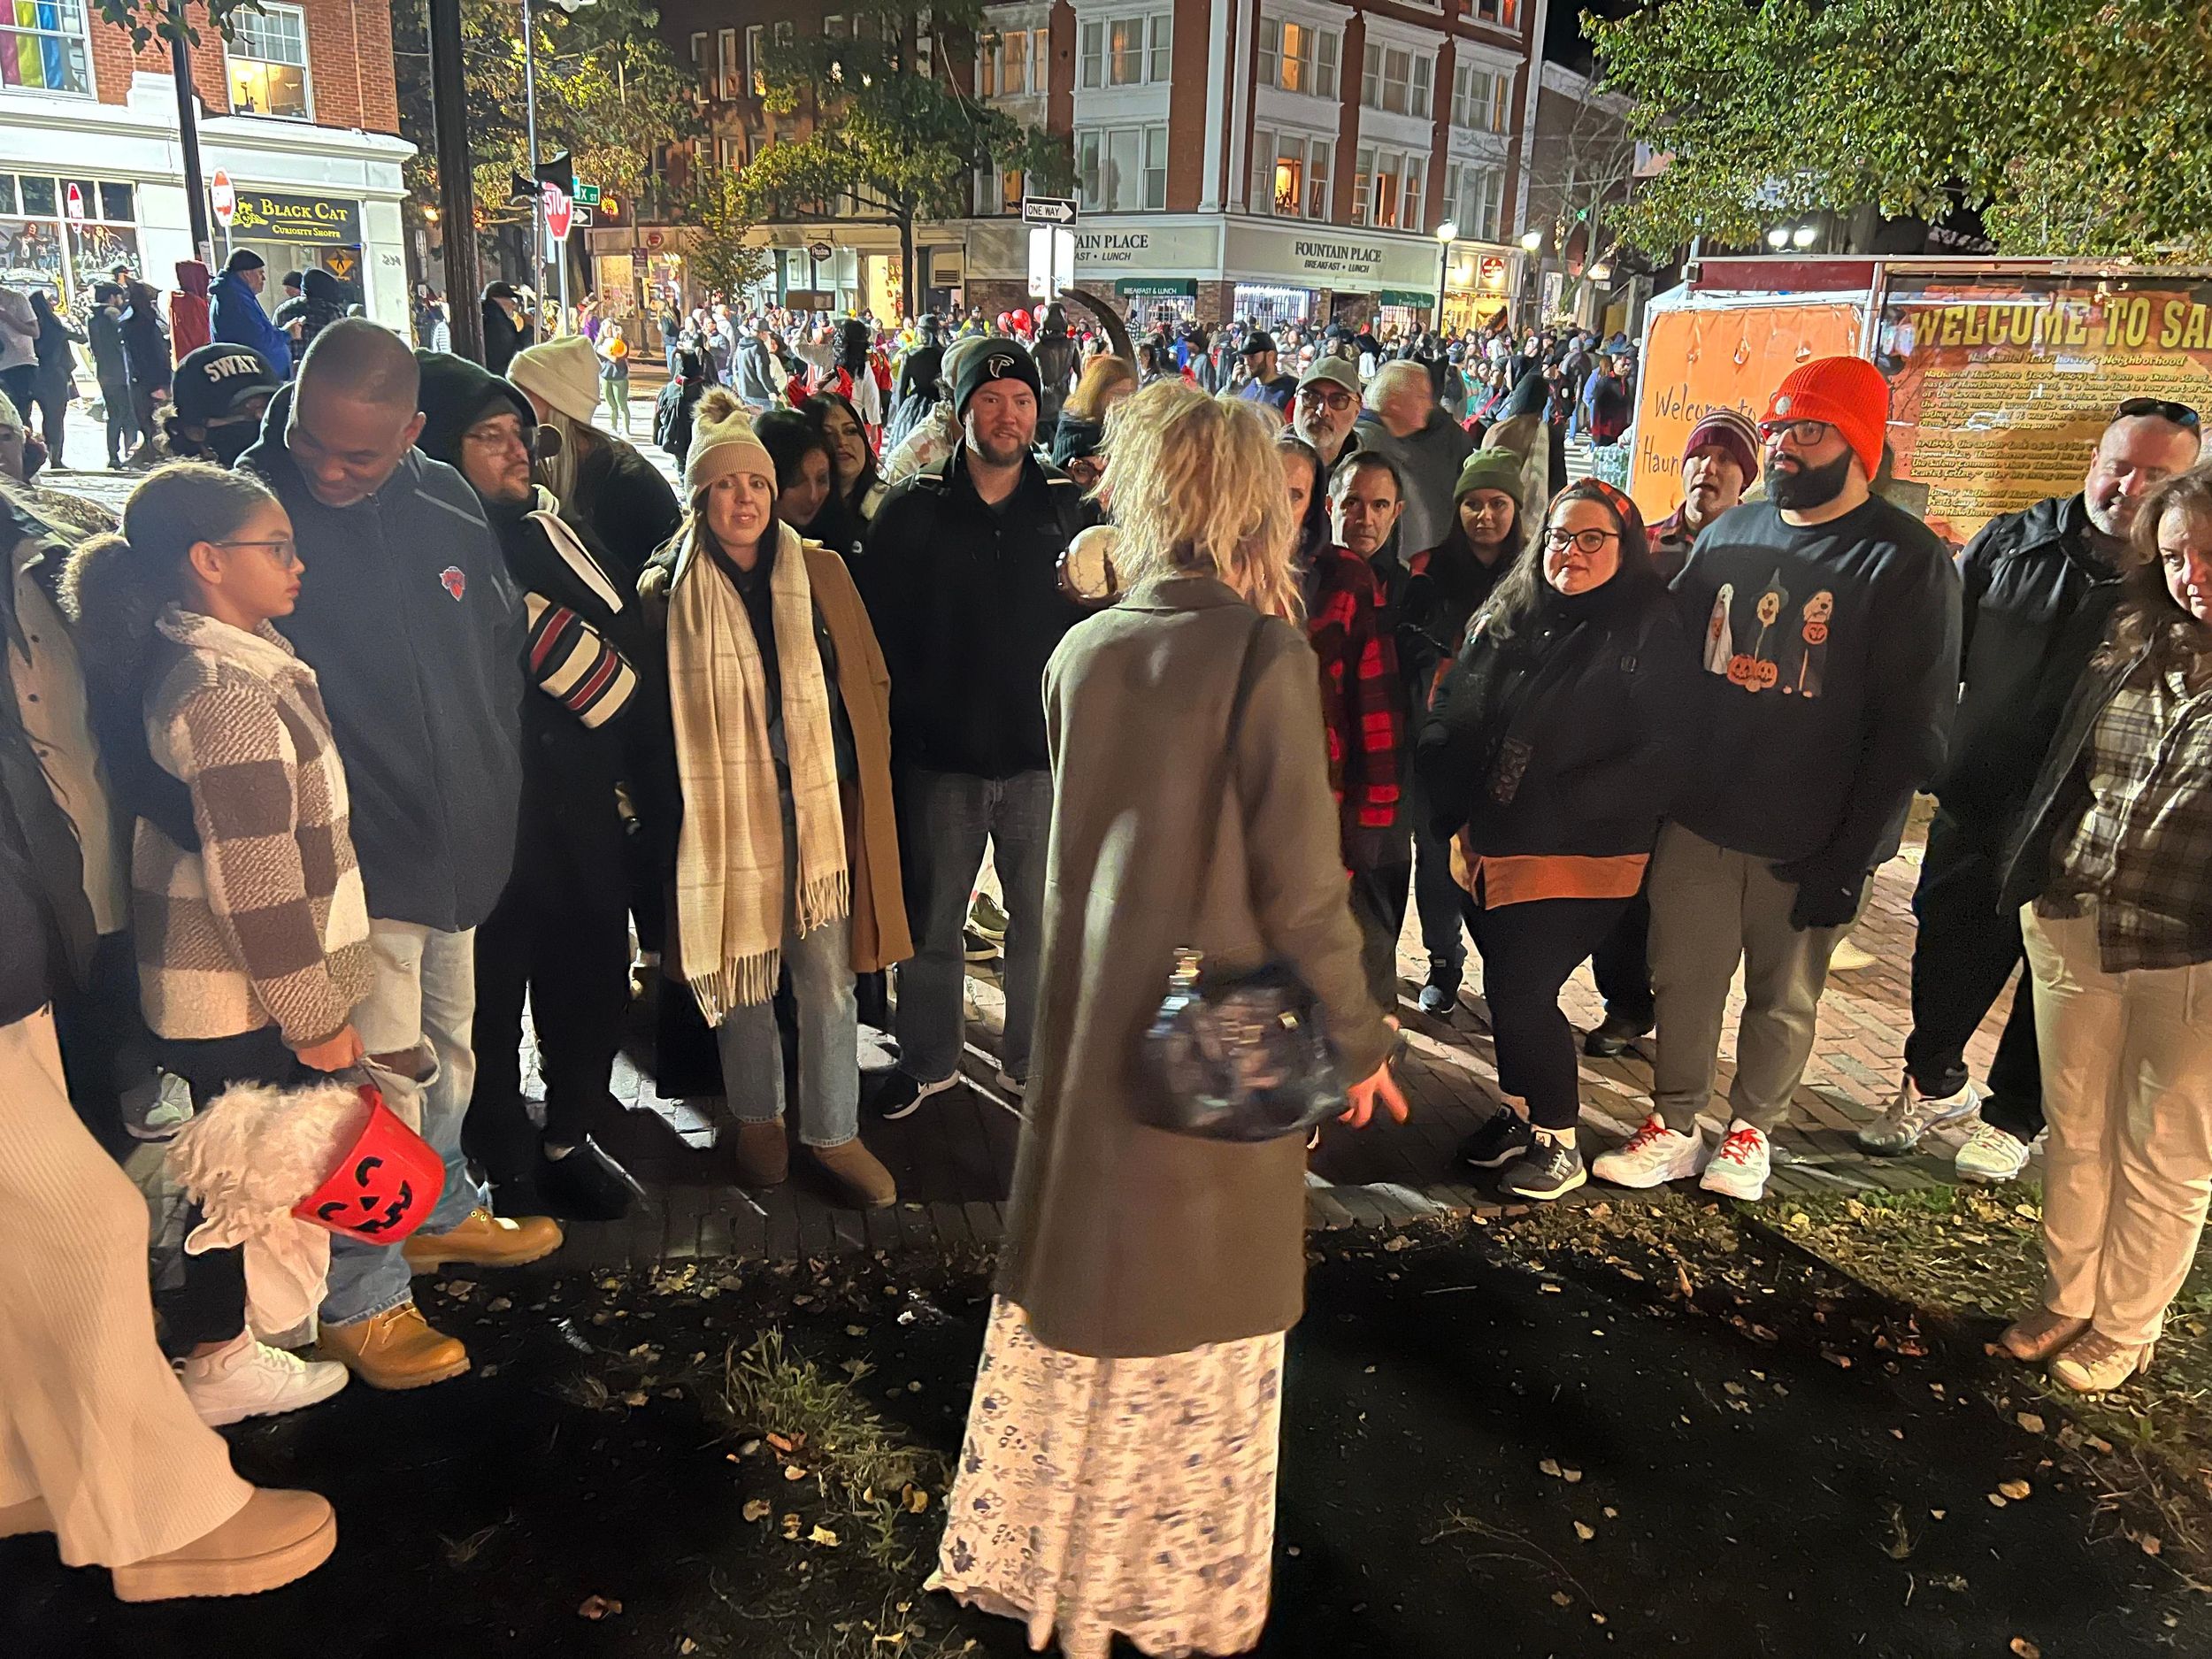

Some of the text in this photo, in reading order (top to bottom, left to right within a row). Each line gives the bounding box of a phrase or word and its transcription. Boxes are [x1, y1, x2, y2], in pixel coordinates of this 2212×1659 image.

[543, 190, 570, 216] STOP
[580, 188, 588, 201] X
[259, 198, 348, 222] BLACK CAT
[1028, 205, 1061, 217] ONE WAY
[272, 225, 312, 236] CURIOSITY
[1074, 234, 1148, 249] AIN PLACE
[1074, 252, 1132, 261] AST LUNCH
[1294, 242, 1382, 263] FOUNTAIN PLACE
[1304, 259, 1371, 273] BREAKFAST LUNCH
[1910, 296, 2212, 349] WELCOME TO SA
[204, 355, 260, 382] SWAT
[1967, 353, 2023, 365] Nathaniel
[2101, 354, 2186, 367] Neighborhood
[1655, 383, 1728, 422] Welco
[1642, 434, 1680, 477] Haun
